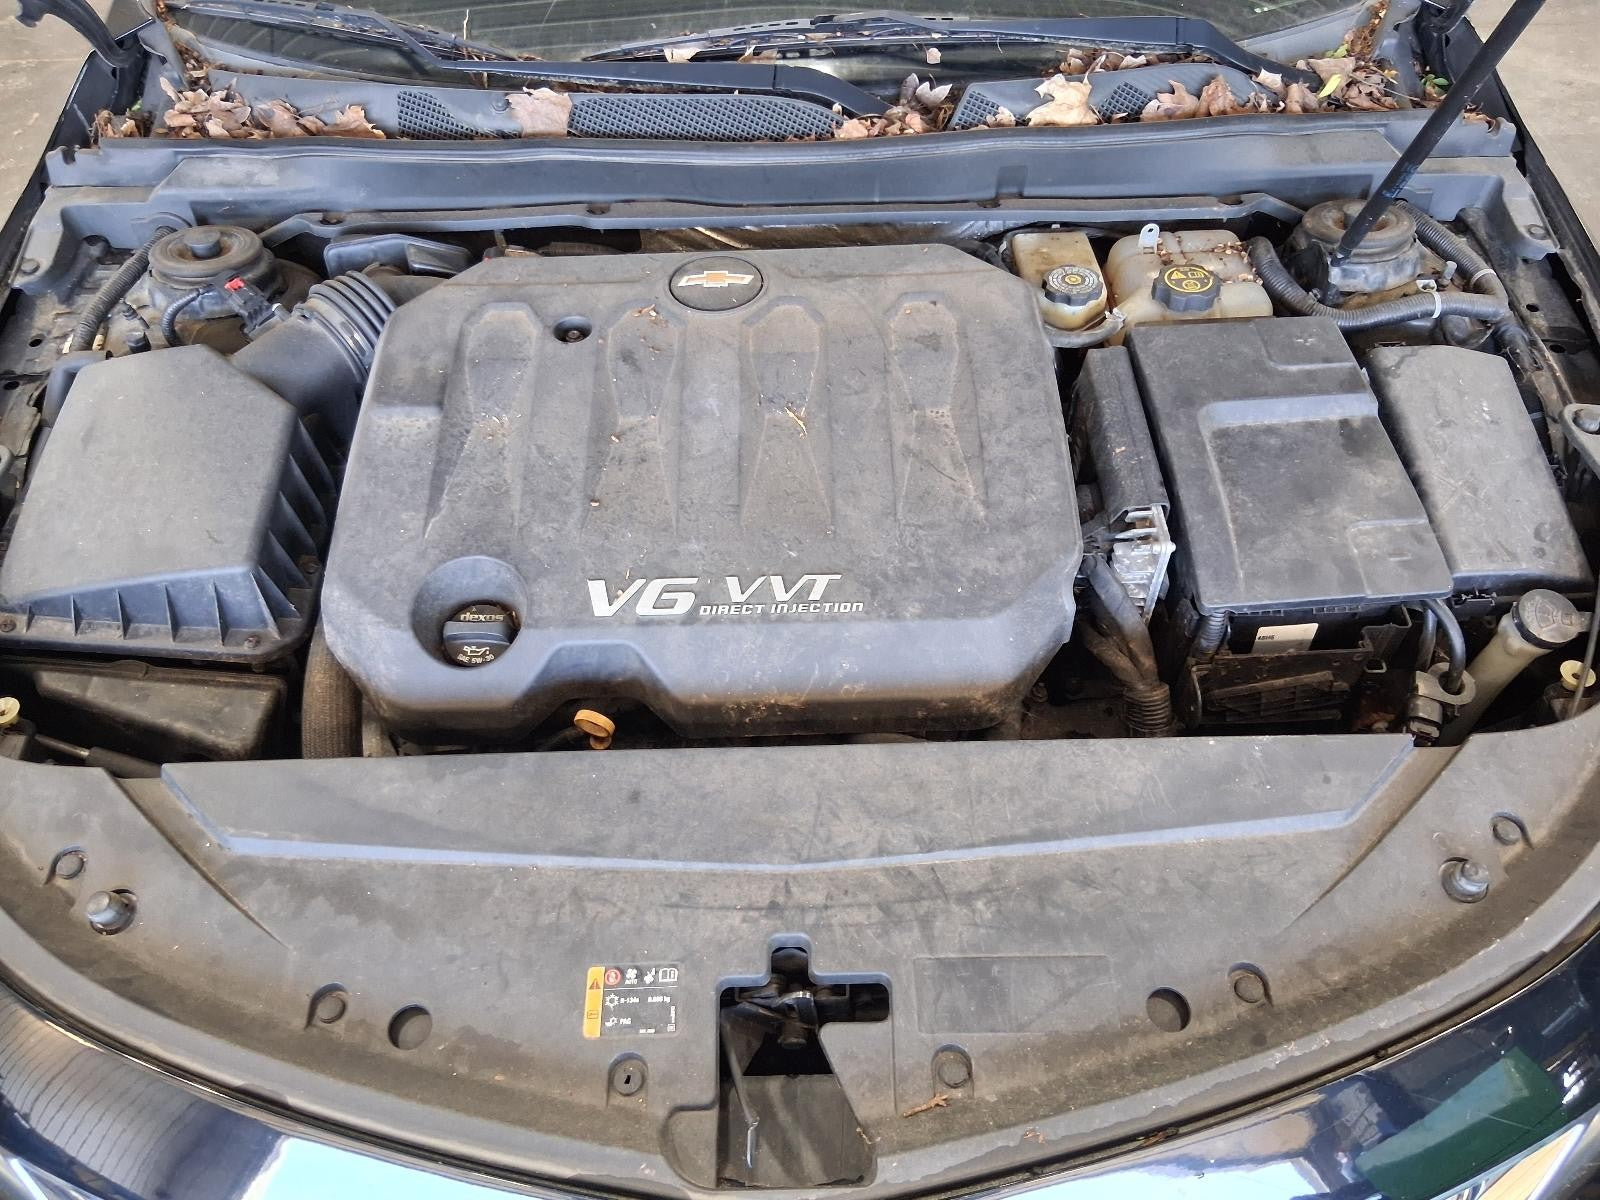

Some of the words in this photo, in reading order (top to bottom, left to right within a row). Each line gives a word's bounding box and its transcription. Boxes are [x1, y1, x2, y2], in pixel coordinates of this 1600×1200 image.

[587, 577, 700, 617] V6
[725, 574, 842, 602] VVT
[699, 604, 766, 616] DIRECT
[771, 602, 864, 615] INJECTION
[460, 612, 504, 622] dexos
[457, 654, 470, 663] SAE
[471, 654, 495, 664] 5W-30
